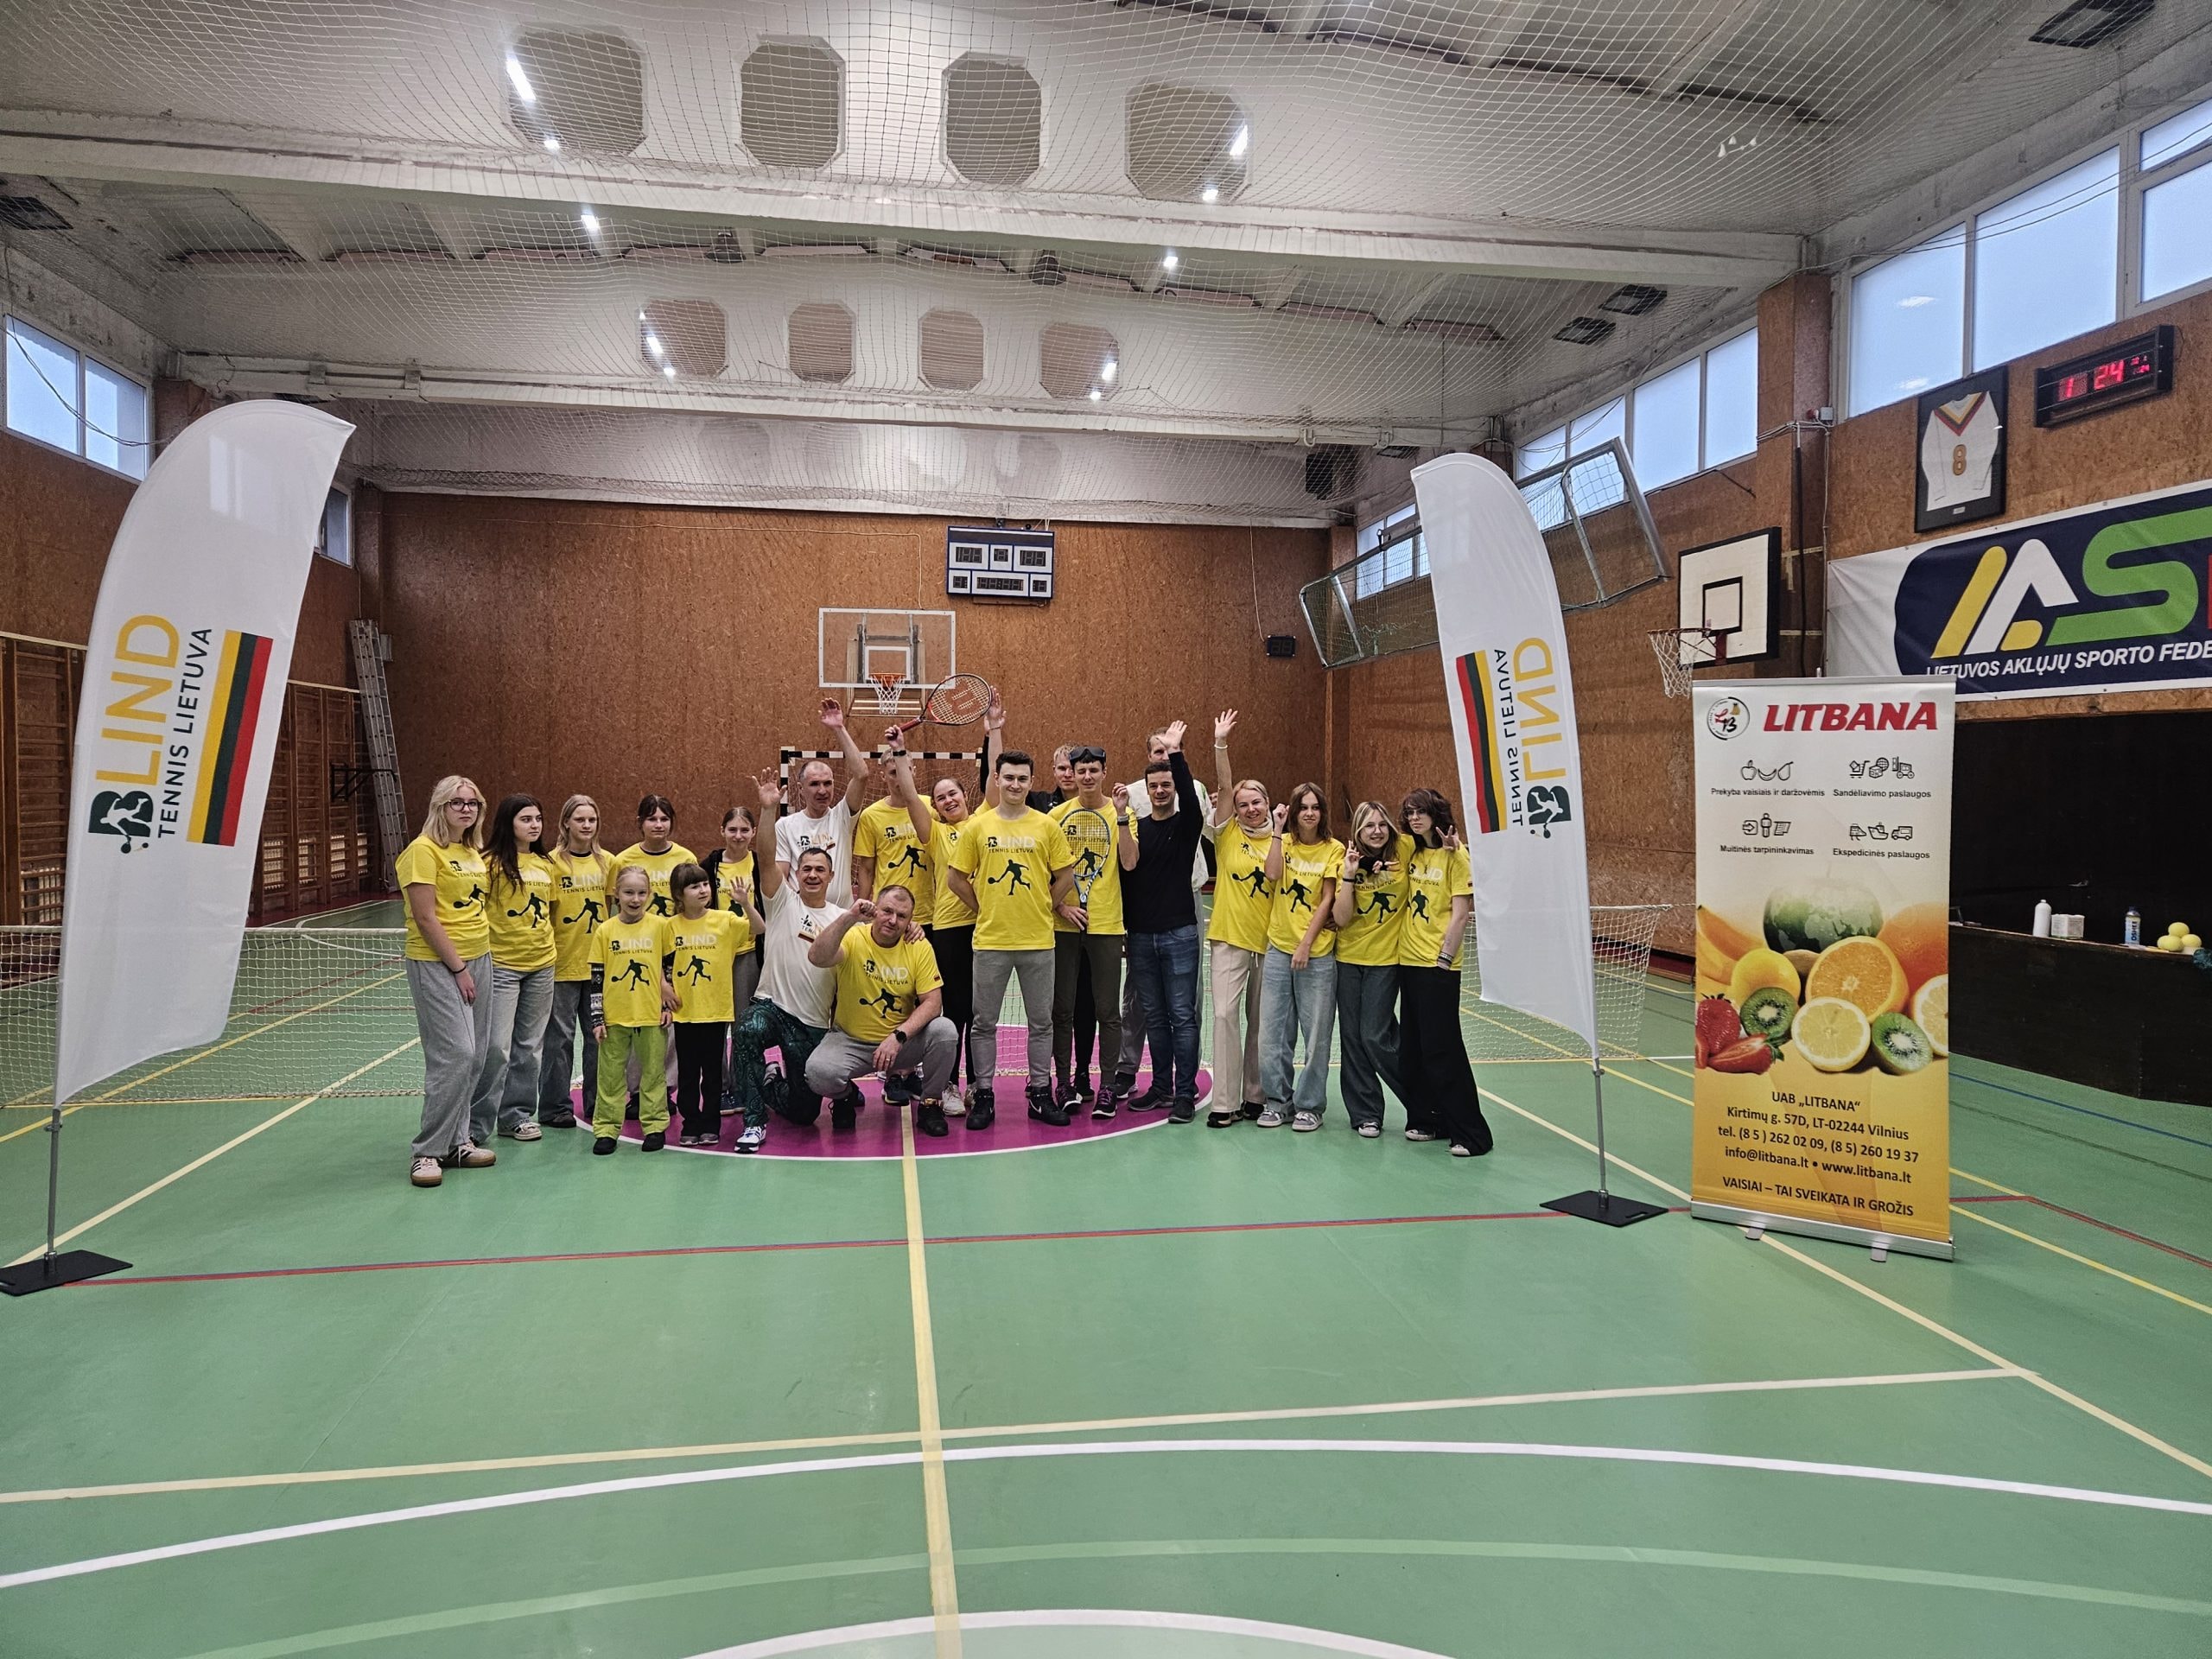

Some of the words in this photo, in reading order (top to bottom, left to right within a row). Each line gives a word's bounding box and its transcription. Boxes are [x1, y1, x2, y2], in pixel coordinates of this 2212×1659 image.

[1951, 443, 1967, 476] 8
[2002, 652, 2071, 676] AKLŲJŲ
[2075, 646, 2155, 669] SPORTO
[88, 614, 180, 838] BLIND
[1763, 702, 1938, 732] LITBANA
[158, 745, 189, 838] TENNIS
[174, 628, 212, 734] LIETUVA
[1711, 788, 1741, 797] Prekyba
[1889, 790, 1931, 798] paslaugos
[985, 836, 1035, 849] BLIND
[1720, 844, 1751, 853] Muitinės
[1753, 845, 1815, 855] tarpininkavimas
[1833, 848, 1885, 857] Ekspedicinės
[1887, 850, 1930, 860] paslaugos
[610, 938, 653, 951] BLIND
[675, 934, 716, 947] BLIND
[1771, 1091, 1796, 1104] UAB
[1727, 1106, 1769, 1124] Kirtimų
[1771, 1113, 1782, 1125] g.
[1783, 1113, 1809, 1129] 57D,
[1813, 1116, 1865, 1135] LT-02244
[1867, 1123, 1910, 1141] Vilnius
[1718, 1125, 1736, 1138] tel.
[1738, 1128, 1751, 1141] (8
[1770, 1131, 1790, 1145] 262
[1793, 1134, 1807, 1147] 02
[1809, 1136, 1827, 1152] 09,
[1831, 1139, 1842, 1153] (8
[1846, 1141, 1857, 1156] 5)
[1860, 1143, 1883, 1158] 260
[1886, 1147, 1900, 1160] 19
[1904, 1149, 1919, 1163] 37
[1725, 1146, 1808, 1169] info@litbana.lt
[1821, 1161, 1911, 1184] www.litbana.lt
[1722, 1176, 1763, 1192] VAISIAI
[1775, 1184, 1793, 1198] TAI
[1796, 1186, 1852, 1206] SVEIKATA
[1853, 1193, 1866, 1208] IR
[1868, 1194, 1914, 1217] GROŽIS
